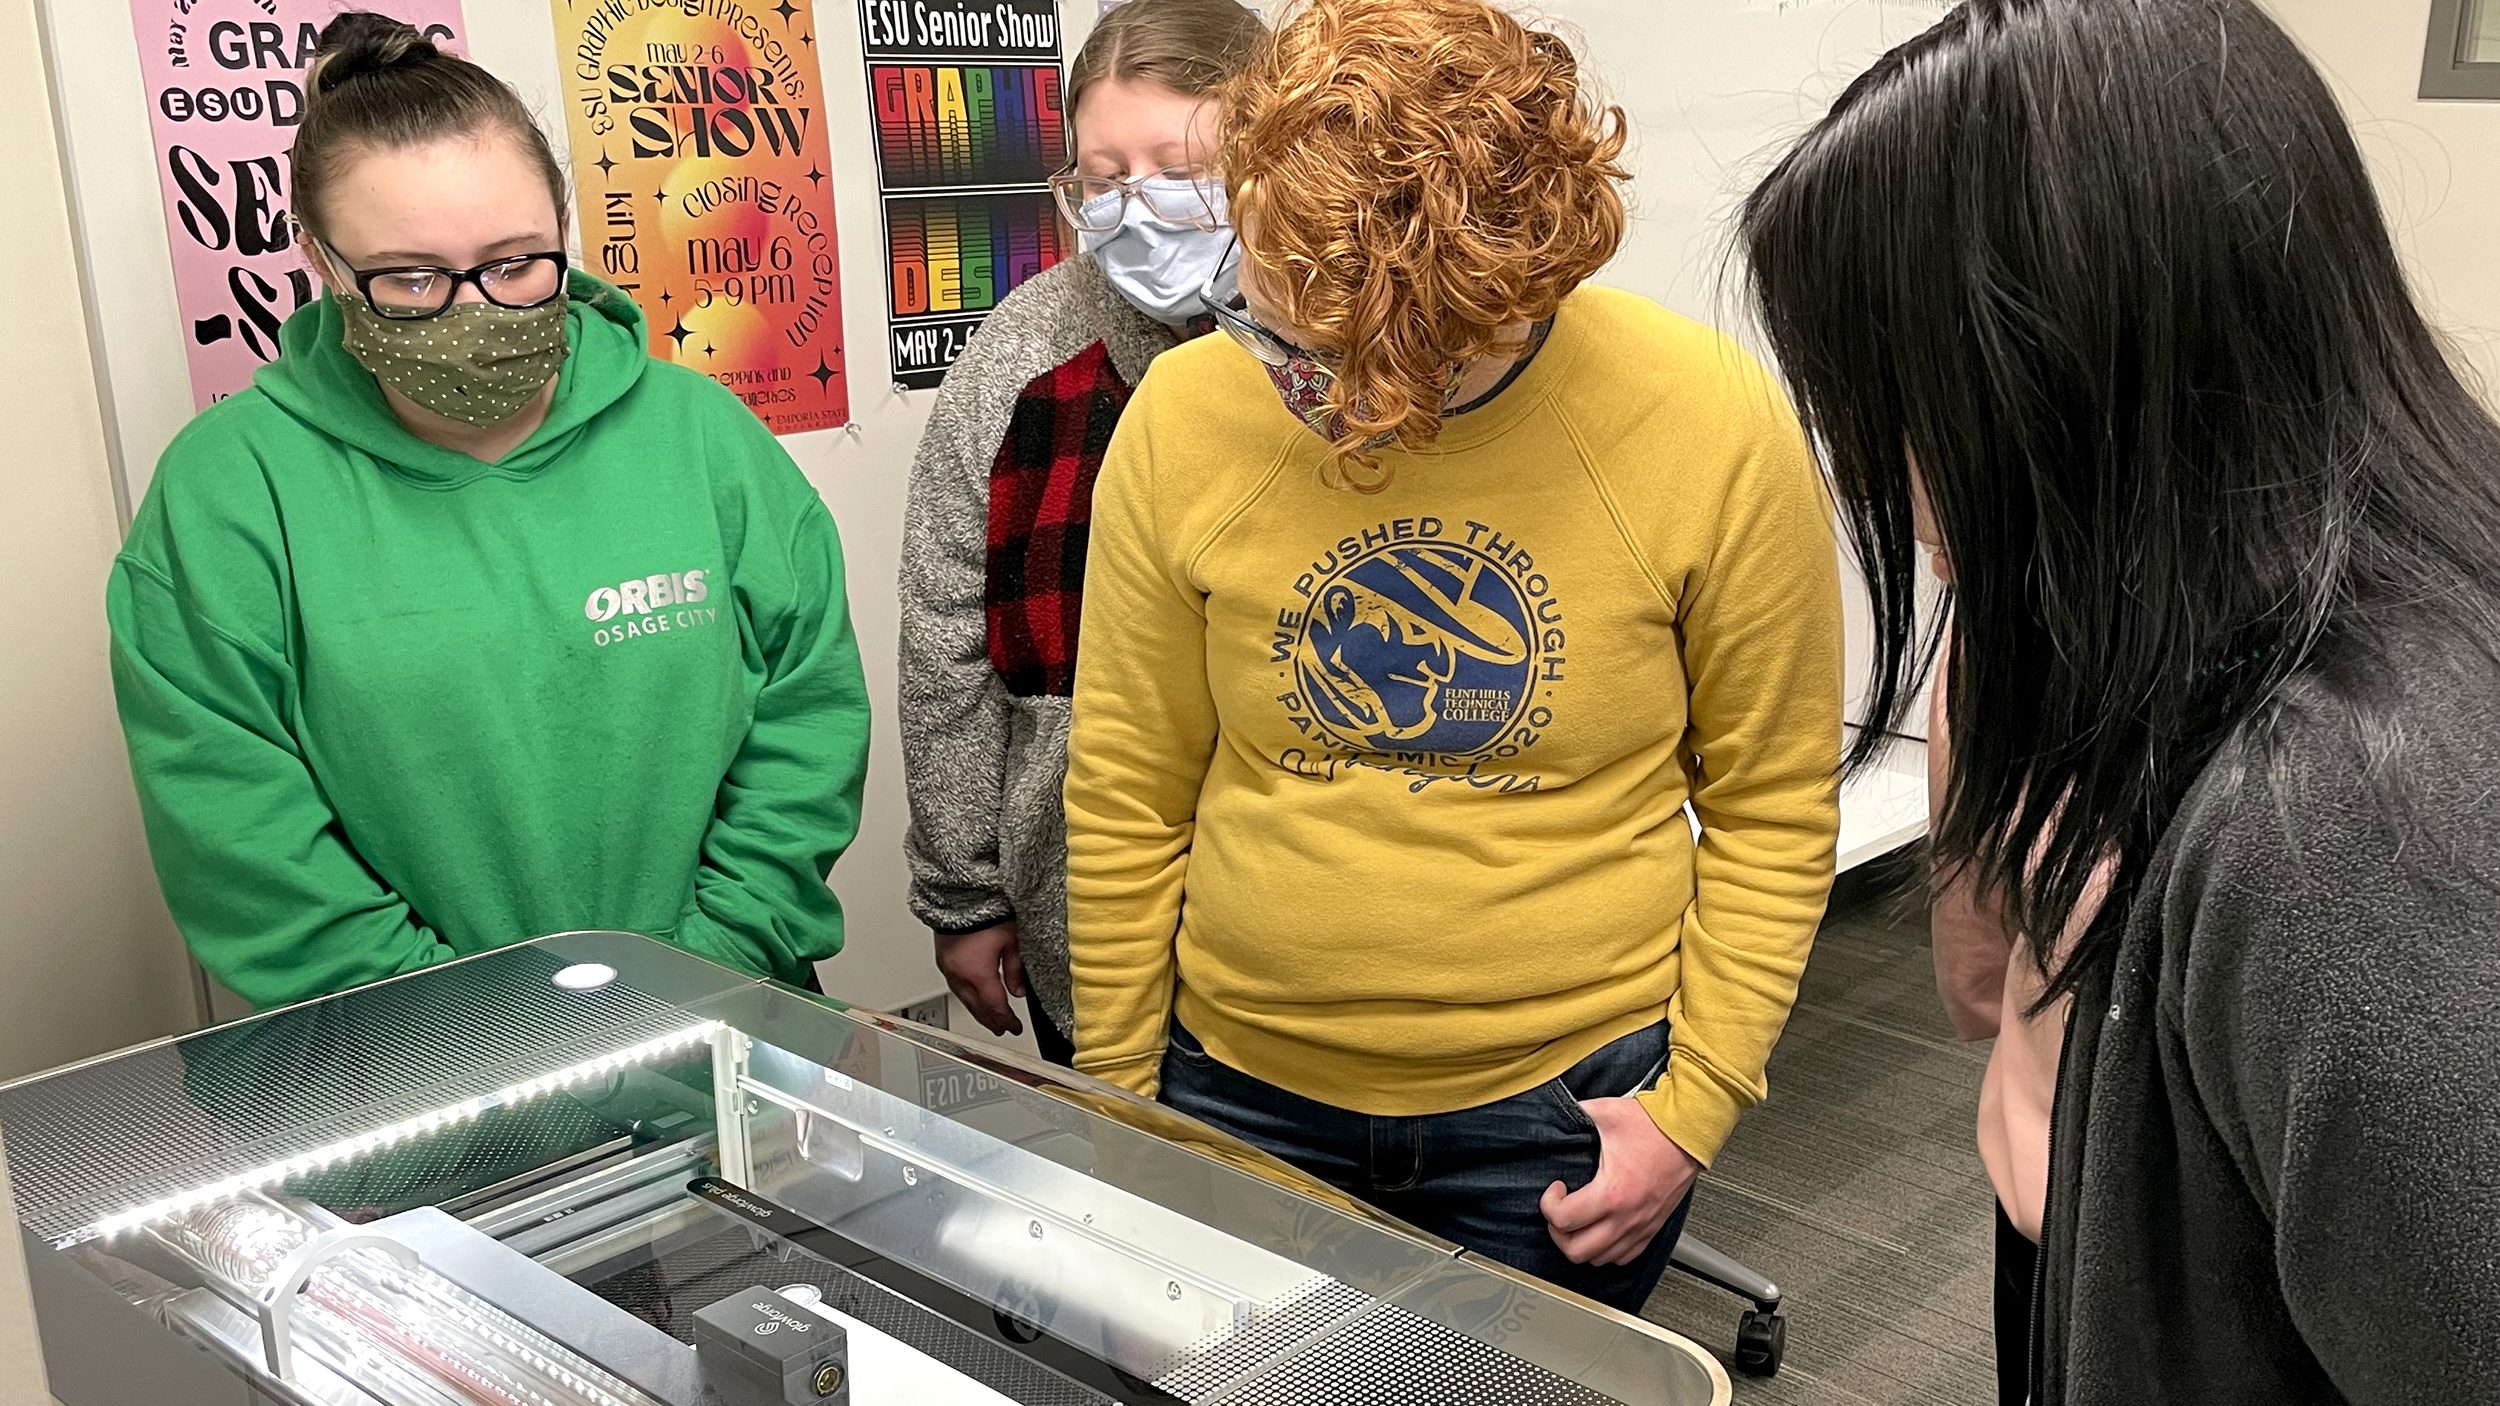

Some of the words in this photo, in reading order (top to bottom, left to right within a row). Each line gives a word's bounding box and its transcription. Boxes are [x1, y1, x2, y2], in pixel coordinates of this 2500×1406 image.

[866, 1, 908, 47] ESU
[916, 1, 992, 48] Senior
[995, 1, 1056, 48] Show
[691, 44, 724, 65] 2-6
[607, 65, 779, 104] SENIOR
[162, 89, 261, 120] ESU
[873, 66, 1062, 140] GRAPHIC
[630, 107, 809, 158] SHOW
[770, 236, 793, 271] 6
[695, 277, 744, 308] 5-9
[896, 329, 937, 367] MAY
[585, 570, 708, 622] ORBIS
[1270, 608, 1302, 663] WE
[1293, 517, 1443, 598] PUSHED
[1464, 521, 1566, 681] THROUGH
[594, 615, 670, 646] OSAGE
[676, 608, 716, 628] CITY
[1443, 698, 1511, 710] TECHNICAL
[1445, 688, 1478, 699] FLINT
[1479, 689, 1511, 700] HILLS
[1442, 708, 1511, 722] COLLEGE
[720, 1192, 773, 1218] glowforge
[752, 1302, 811, 1332] glowforge
